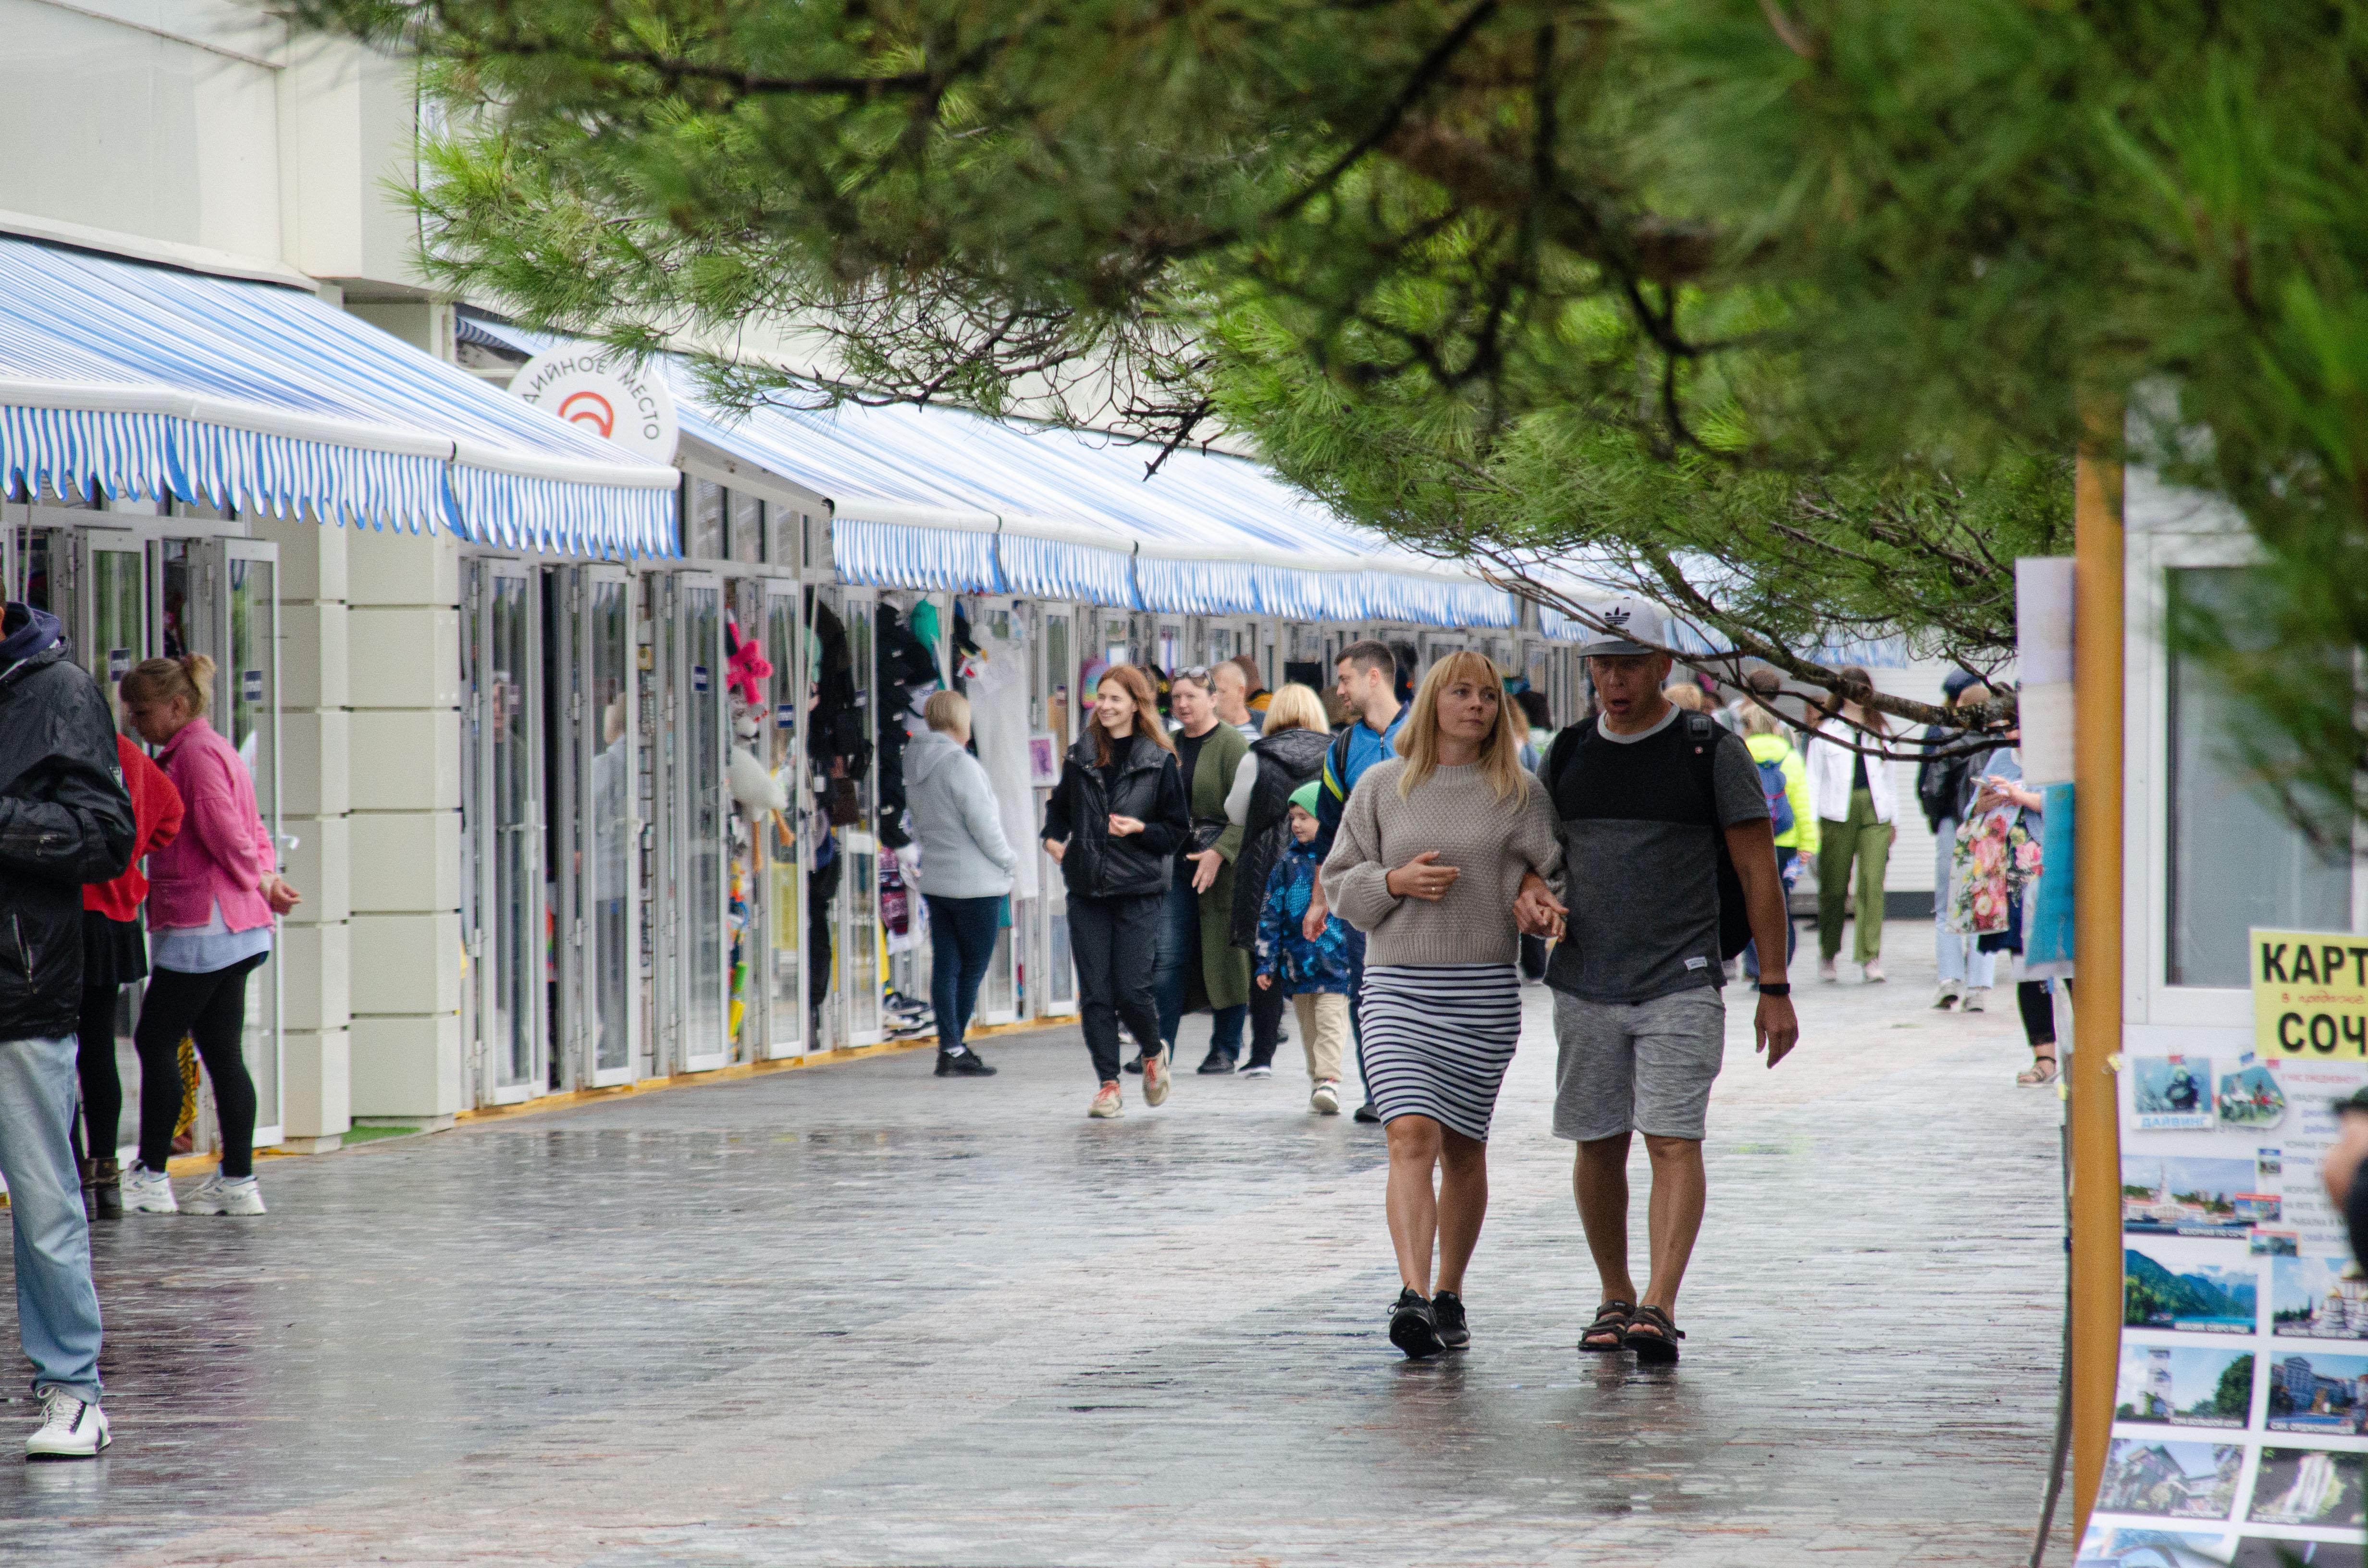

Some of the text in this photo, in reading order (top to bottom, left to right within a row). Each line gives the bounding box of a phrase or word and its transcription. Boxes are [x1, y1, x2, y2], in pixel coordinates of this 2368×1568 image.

[617, 368, 659, 440] МЕСТО
[2261, 943, 2368, 988] КАРТ
[2278, 1012, 2367, 1055] СОЧ
